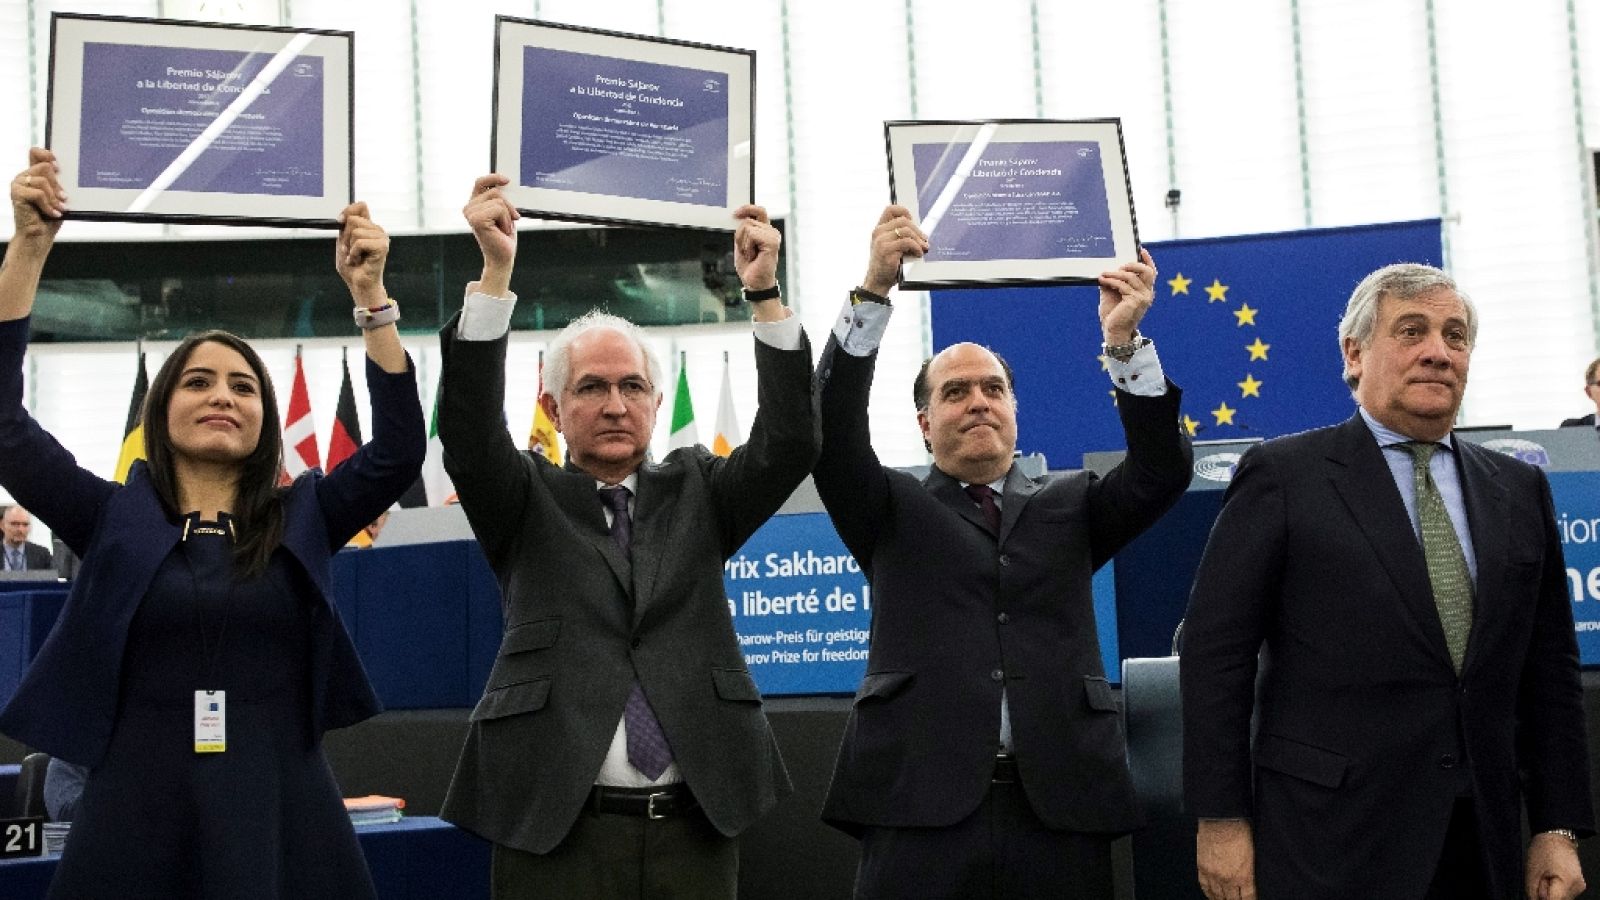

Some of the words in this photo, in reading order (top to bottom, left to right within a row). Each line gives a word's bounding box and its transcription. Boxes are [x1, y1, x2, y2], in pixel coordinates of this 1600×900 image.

[166, 66, 204, 78] Premio
[145, 80, 155, 89] la
[157, 80, 201, 92] Libertad
[587, 87, 624, 100] Libertad
[743, 588, 820, 617] liberté
[825, 586, 857, 613] de
[806, 629, 824, 643] für
[771, 650, 800, 664] Prize
[802, 649, 819, 662] for
[5, 823, 36, 852] 21
